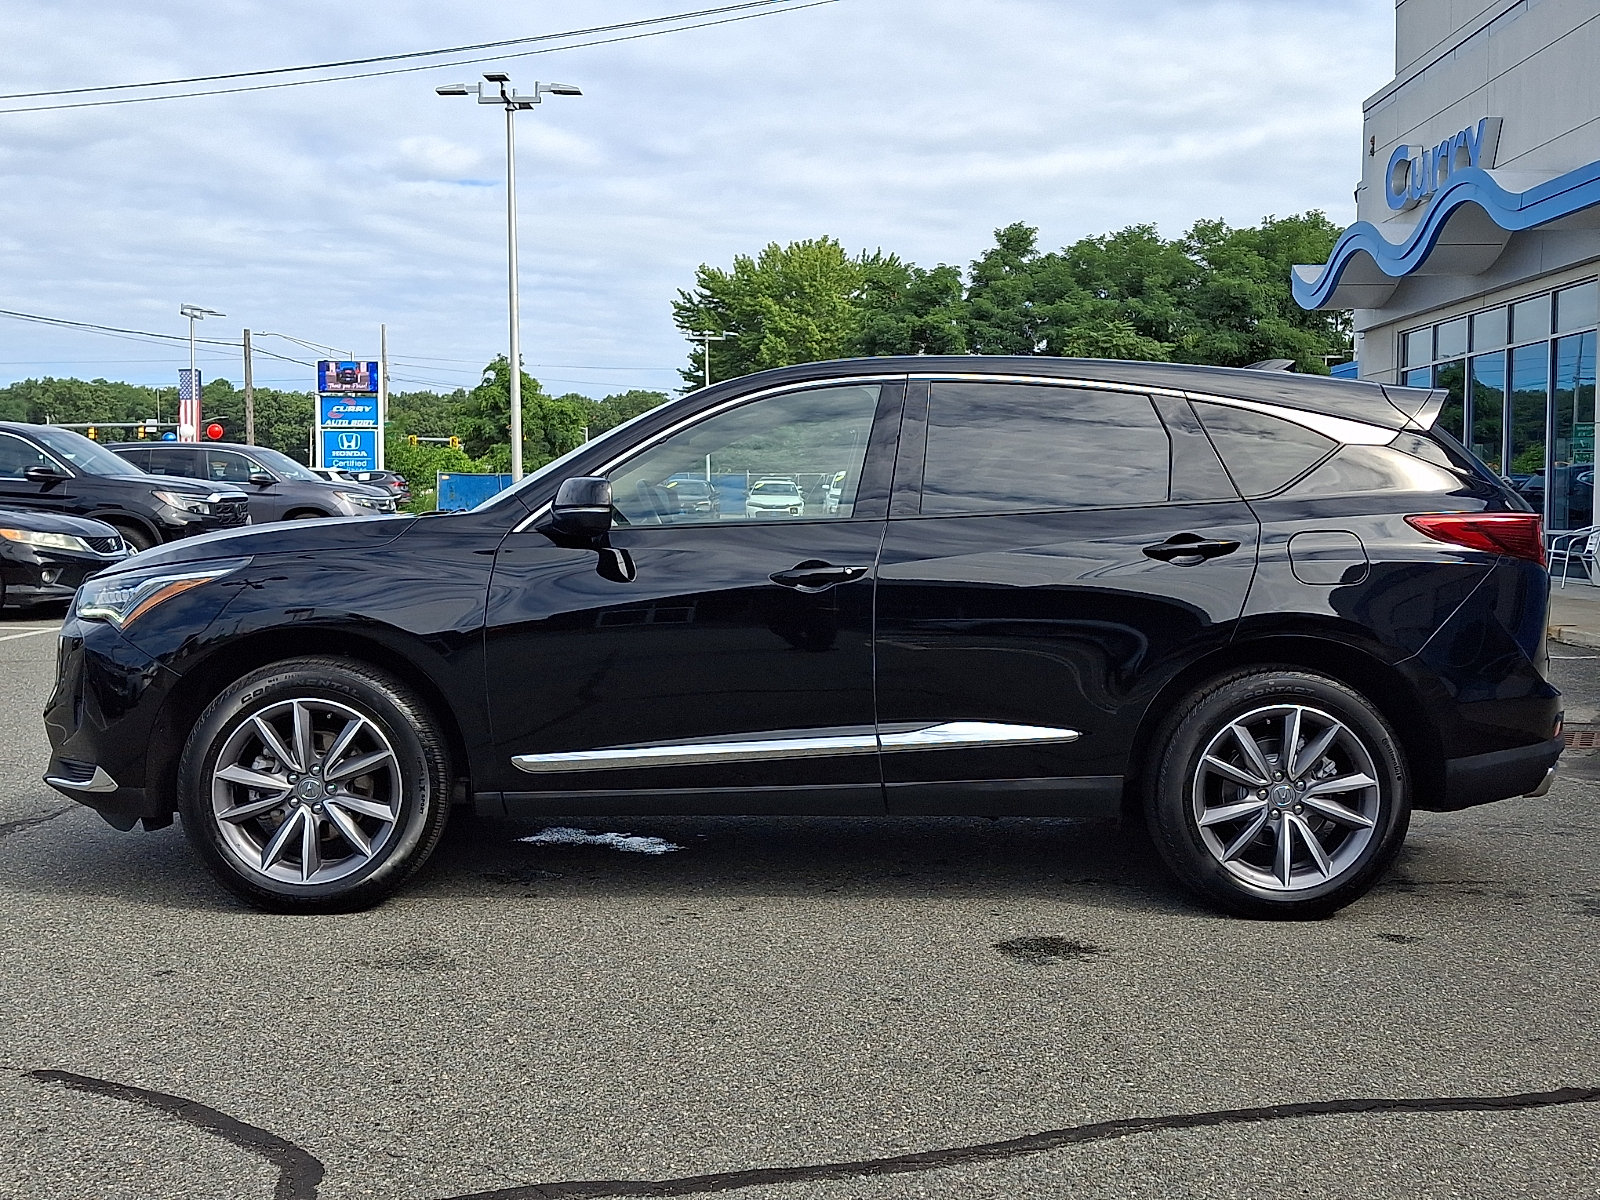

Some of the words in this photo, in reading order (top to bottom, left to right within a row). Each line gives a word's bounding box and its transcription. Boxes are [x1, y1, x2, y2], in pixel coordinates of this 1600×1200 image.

[1385, 117, 1503, 210] Curry
[332, 459, 367, 467] Certified
[241, 678, 359, 704] CONNENTAL
